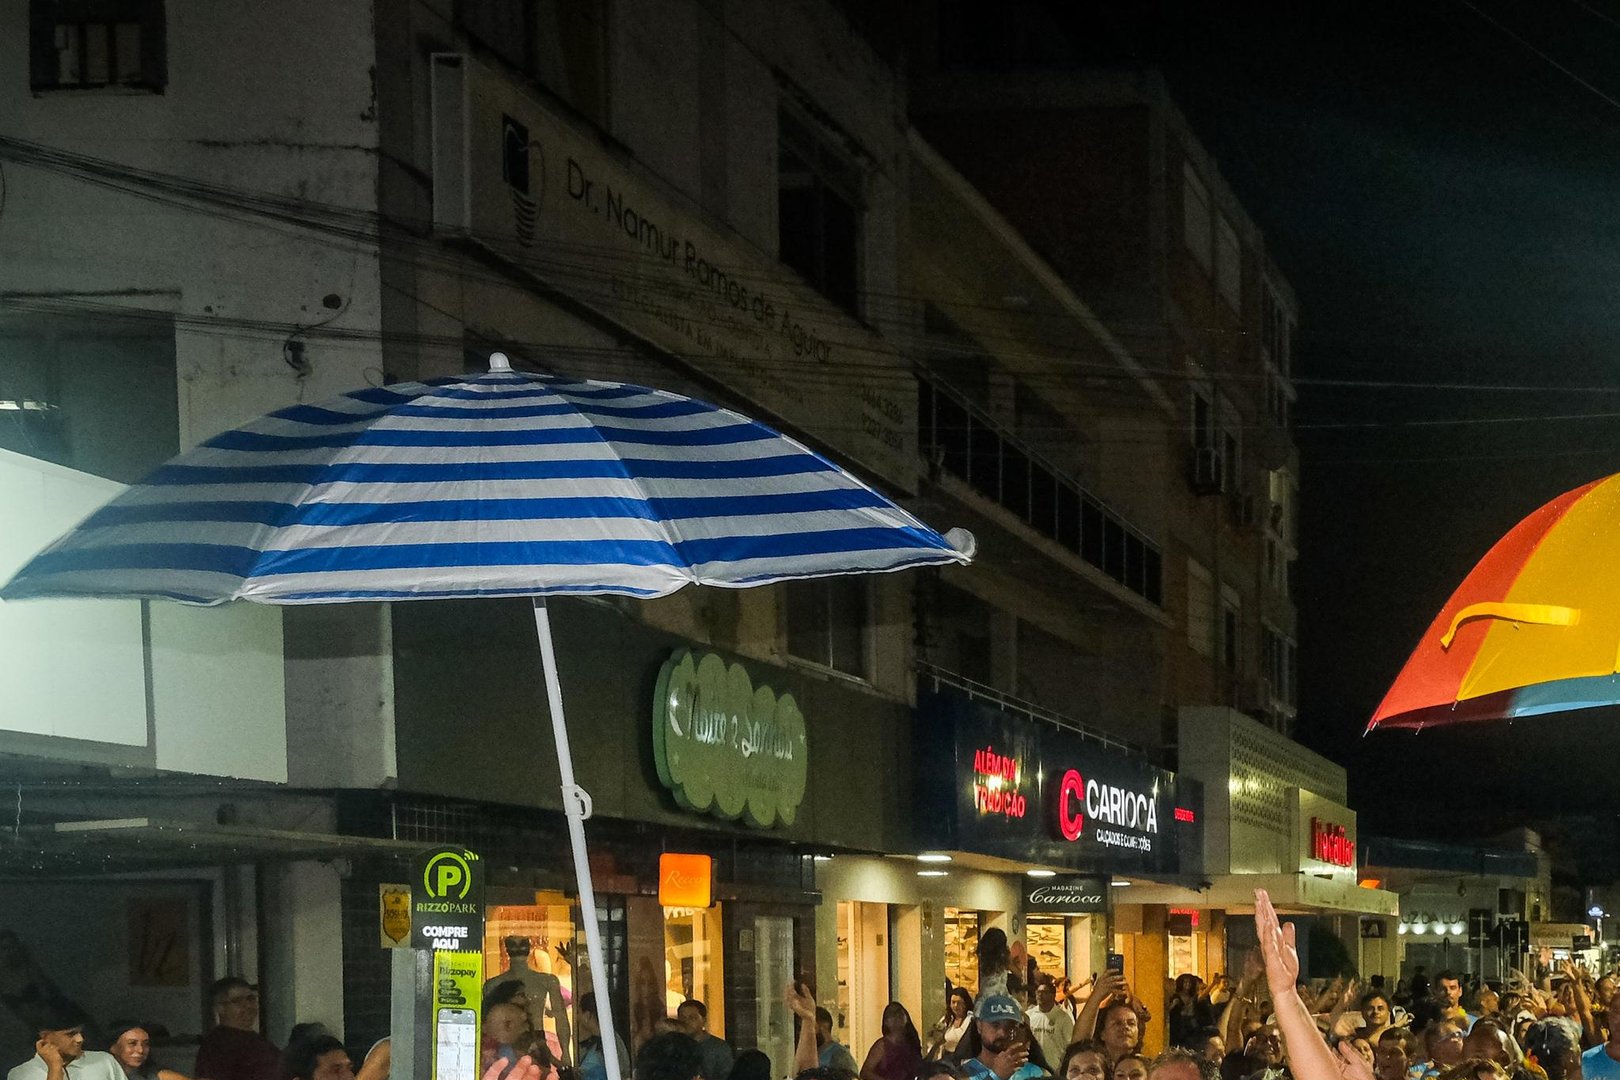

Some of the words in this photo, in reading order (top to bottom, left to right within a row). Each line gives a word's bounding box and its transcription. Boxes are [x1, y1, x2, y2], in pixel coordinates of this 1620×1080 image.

[566, 159, 599, 214] Dr.
[606, 192, 681, 266] Namur
[684, 241, 750, 313] Ramos
[753, 289, 777, 325] de
[781, 311, 832, 364] Aguiar
[973, 745, 1002, 777] ALÉM
[1002, 757, 1018, 783] DA
[973, 784, 1026, 823] TRADIÇÃO
[1086, 778, 1158, 834] CARIOCA
[1028, 886, 1103, 905] Carioca
[422, 925, 469, 938] COMPRE
[1400, 911, 1419, 925] UZ
[432, 938, 460, 949] AQUI
